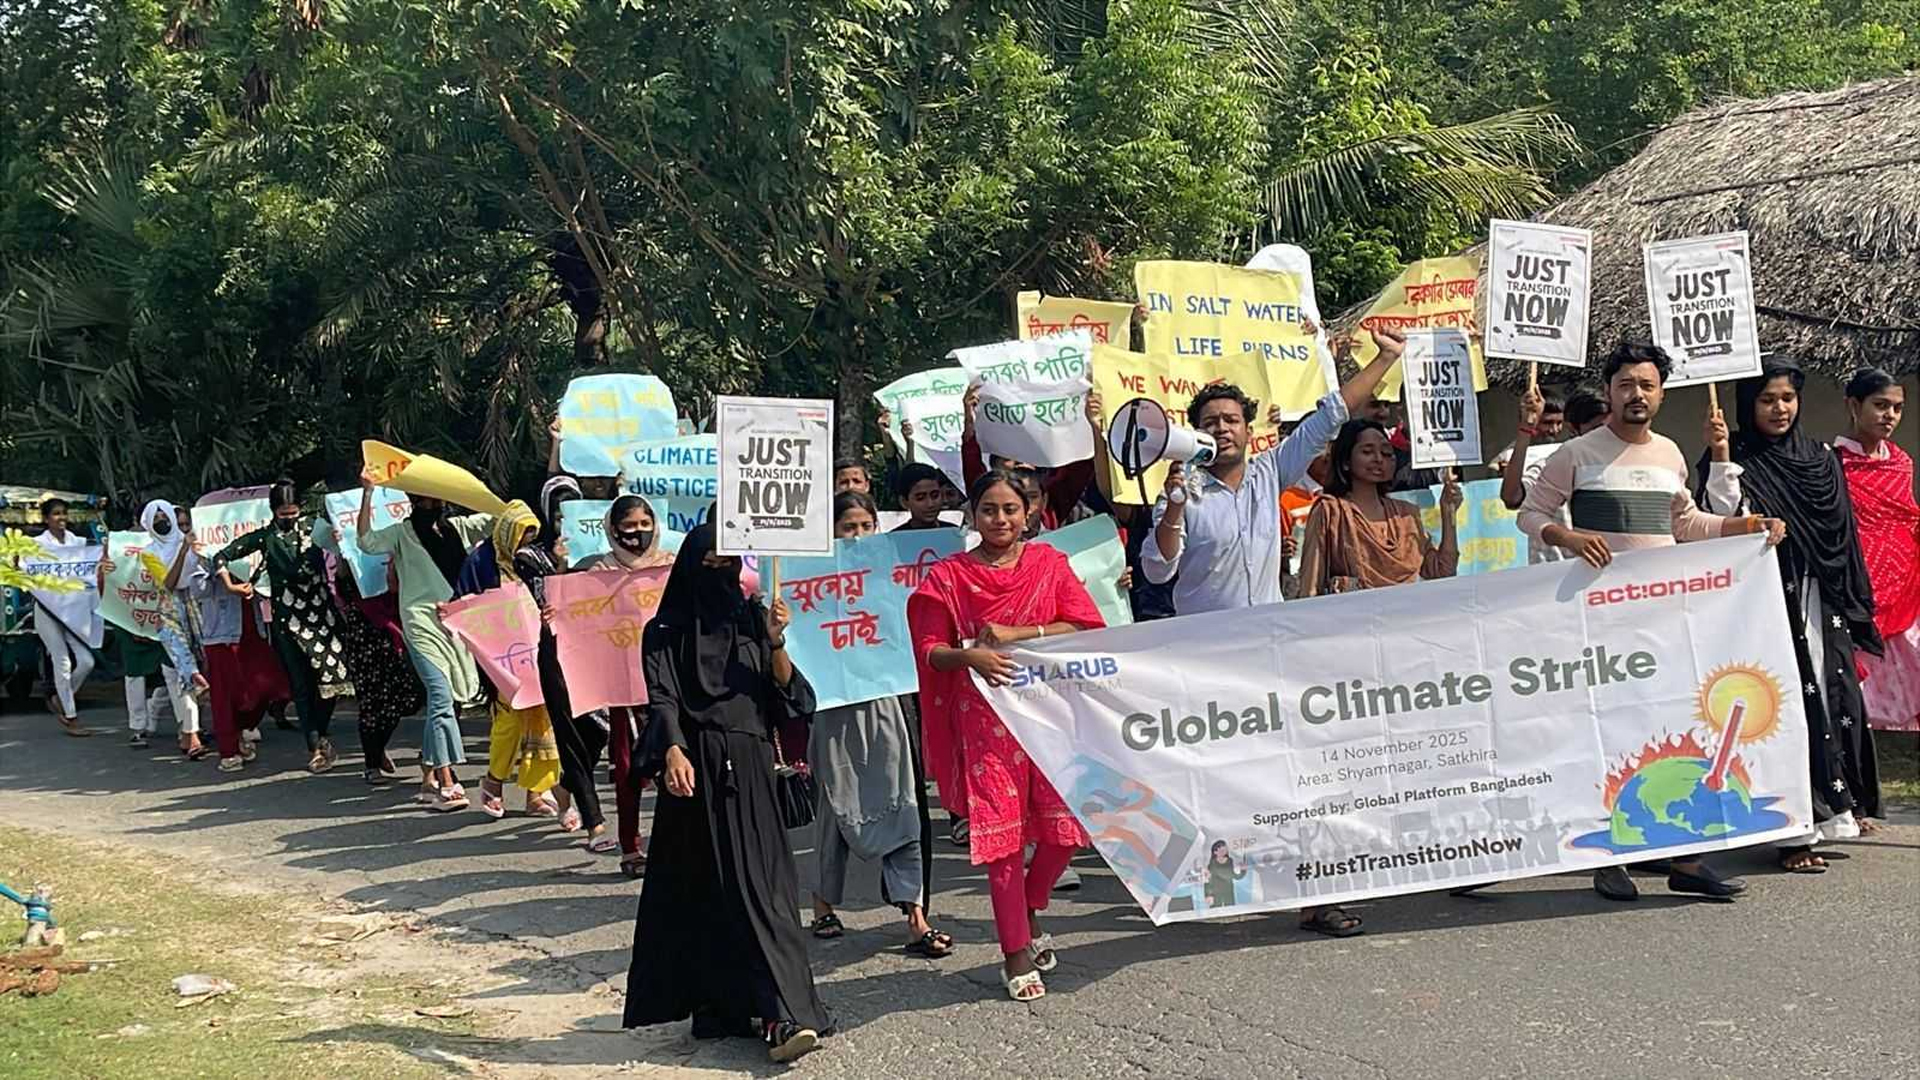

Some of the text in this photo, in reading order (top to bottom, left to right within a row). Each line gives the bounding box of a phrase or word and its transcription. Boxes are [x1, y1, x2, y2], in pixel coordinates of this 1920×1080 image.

[1507, 255, 1571, 284] JUST
[1507, 280, 1571, 297] TRANSITION
[1668, 268, 1730, 302] JUST
[1147, 292, 1172, 313] IN
[1186, 295, 1231, 316] SALT
[1504, 292, 1569, 327] NOW
[1670, 297, 1735, 315] TRANSITION
[1671, 309, 1734, 347] NOW
[1176, 337, 1222, 356] LIFE
[1118, 371, 1146, 394] WE
[1418, 360, 1460, 387] JUST
[1420, 387, 1465, 398] TRANSITION
[1422, 399, 1465, 430] NOW
[634, 448, 717, 465] CLIMATE
[738, 436, 811, 467] JUST
[629, 477, 717, 498] JUSTICE
[739, 467, 812, 480] TRANSITION
[738, 481, 811, 516] NOW
[200, 524, 229, 544] LOSS
[820, 610, 886, 650] চাই
[1012, 657, 1118, 687] SHARUB
[1122, 645, 1657, 751] Global Climate Strike
[1321, 731, 1468, 764] 14 November 2025
[1297, 748, 1498, 788] Area: Shyamnagar, Satkhira
[1253, 771, 1553, 826] Supported by: Global Platform Bangladesh
[1295, 835, 1523, 881] #JustTransitionNow
